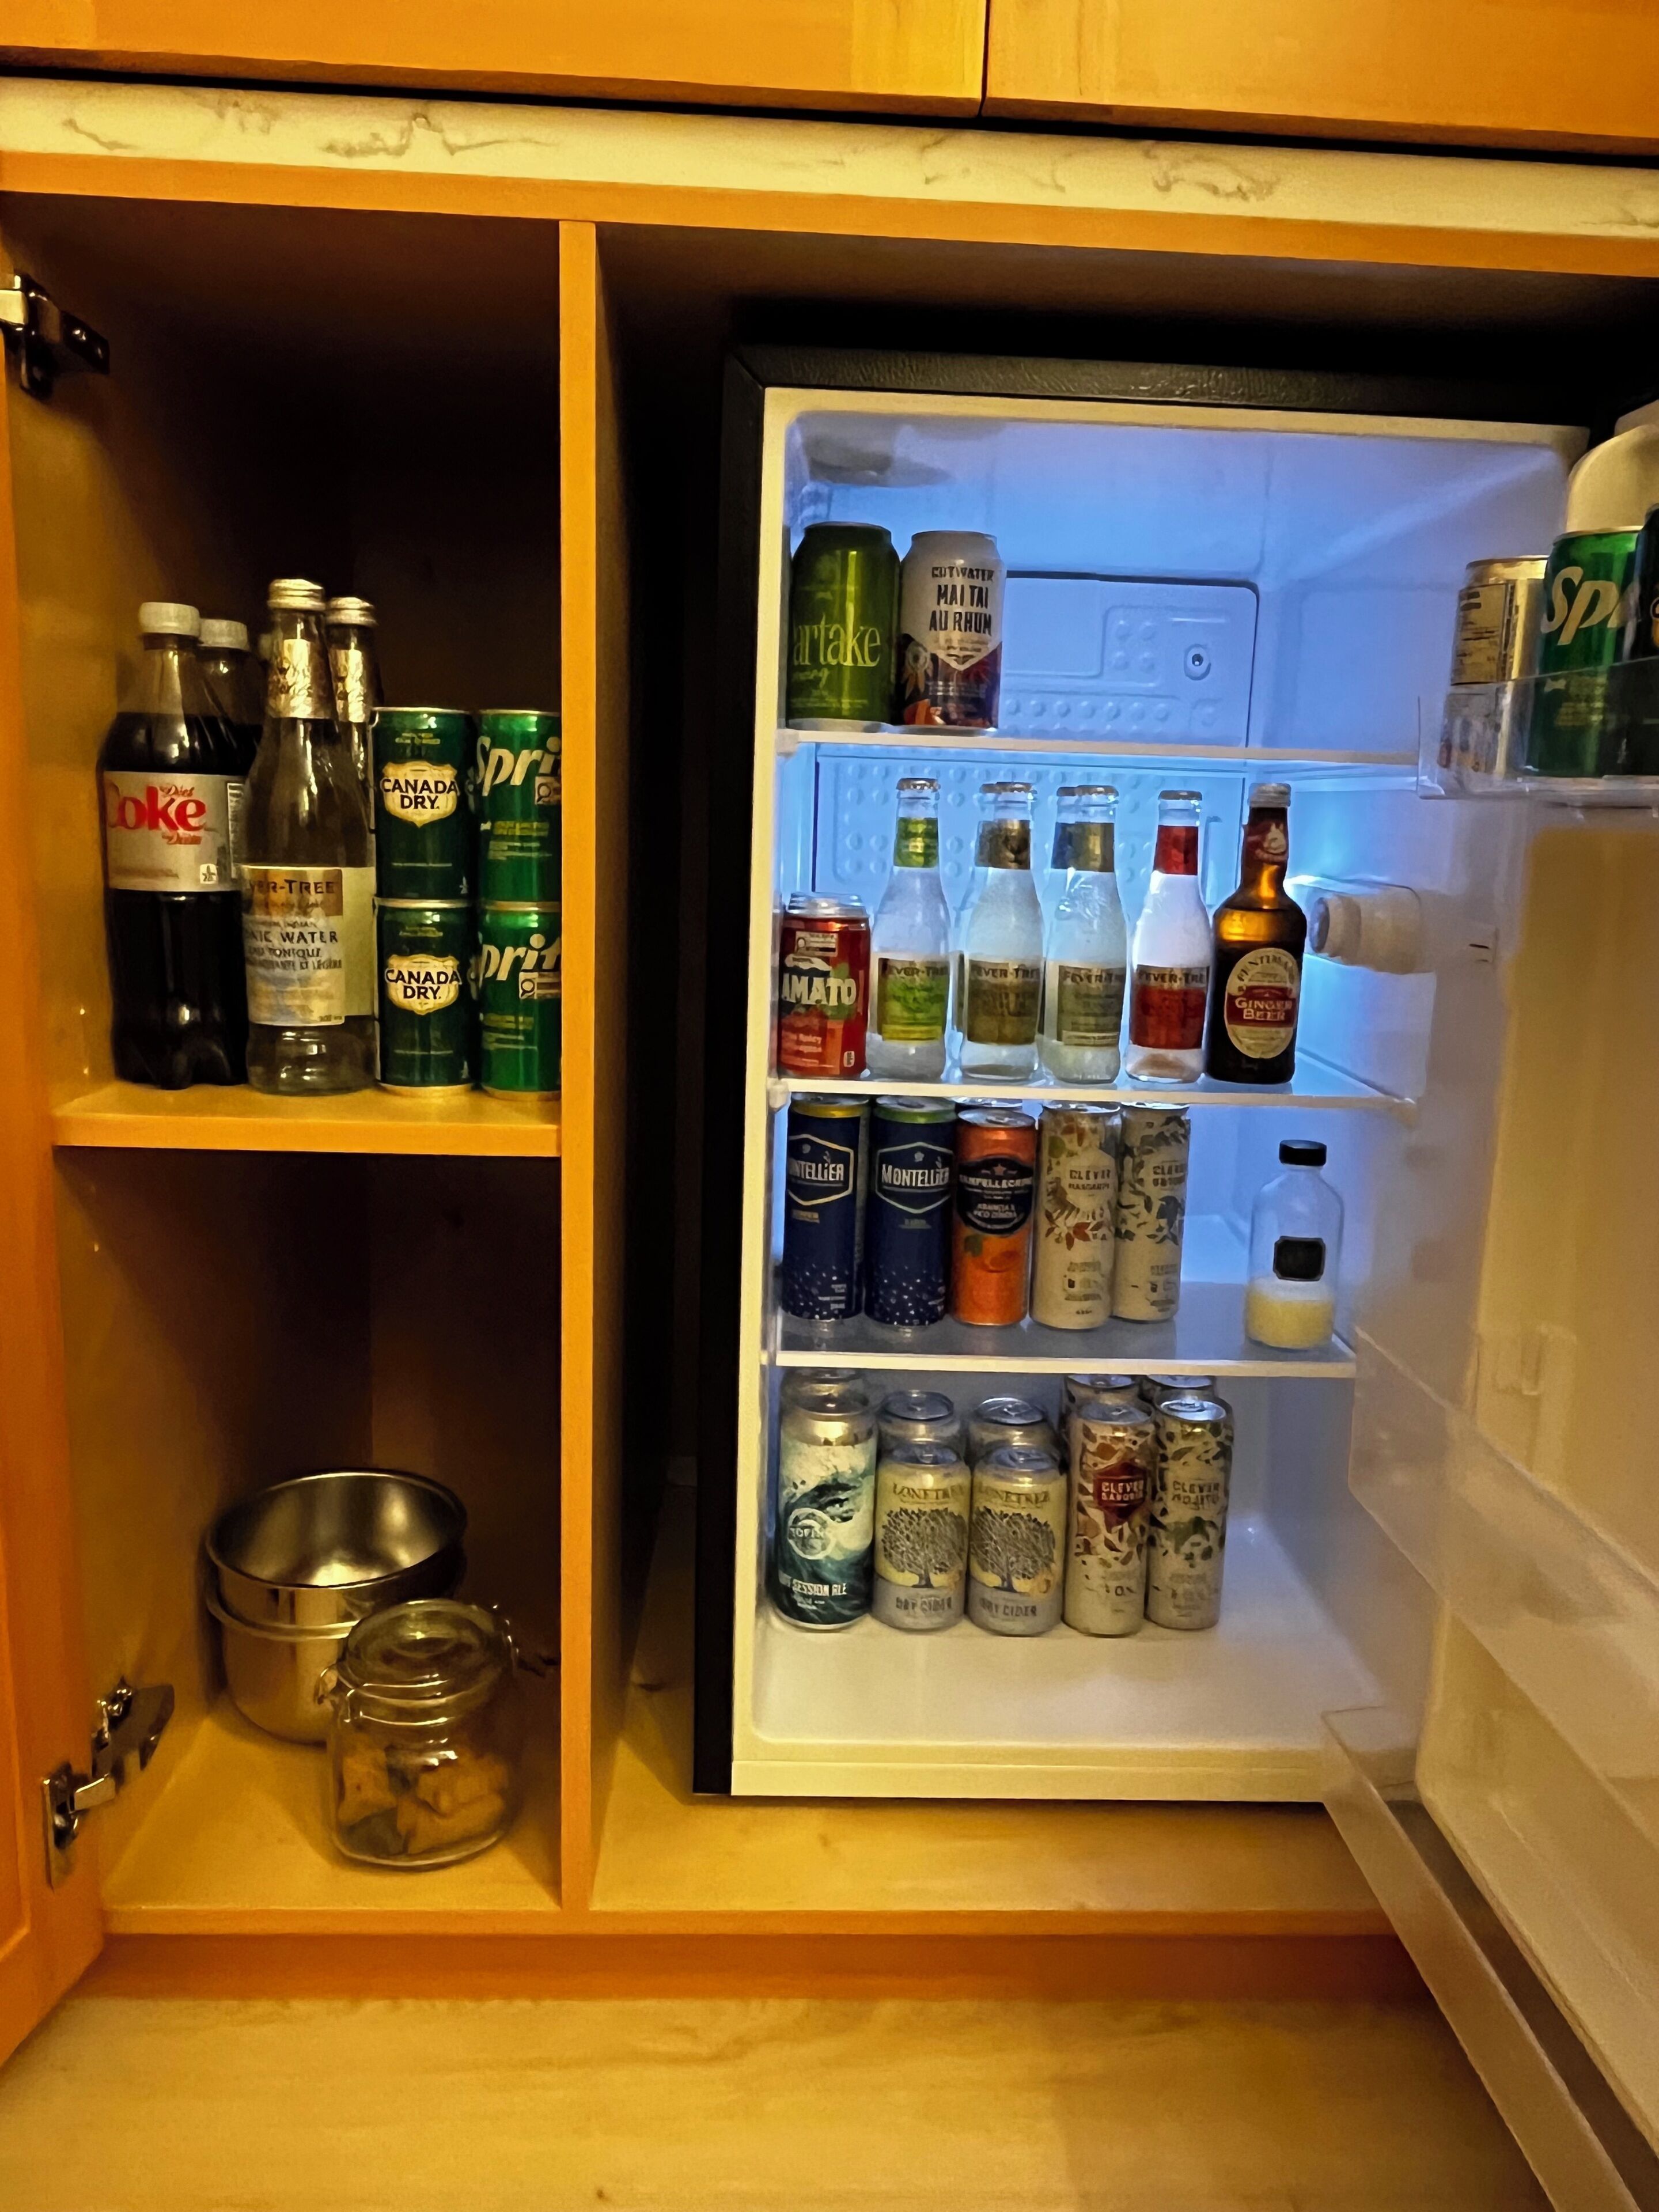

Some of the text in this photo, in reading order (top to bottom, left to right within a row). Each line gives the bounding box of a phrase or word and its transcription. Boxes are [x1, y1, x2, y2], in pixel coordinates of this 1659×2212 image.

[937, 584, 988, 609] MAI TAI
[929, 610, 991, 636] AU RHUM
[381, 778, 459, 796] CANADA
[400, 794, 440, 809] DRY
[281, 931, 338, 944] WATER
[386, 968, 462, 986] CANADA
[403, 986, 441, 1001] DRY
[1003, 1604, 1037, 1616] CIDER
